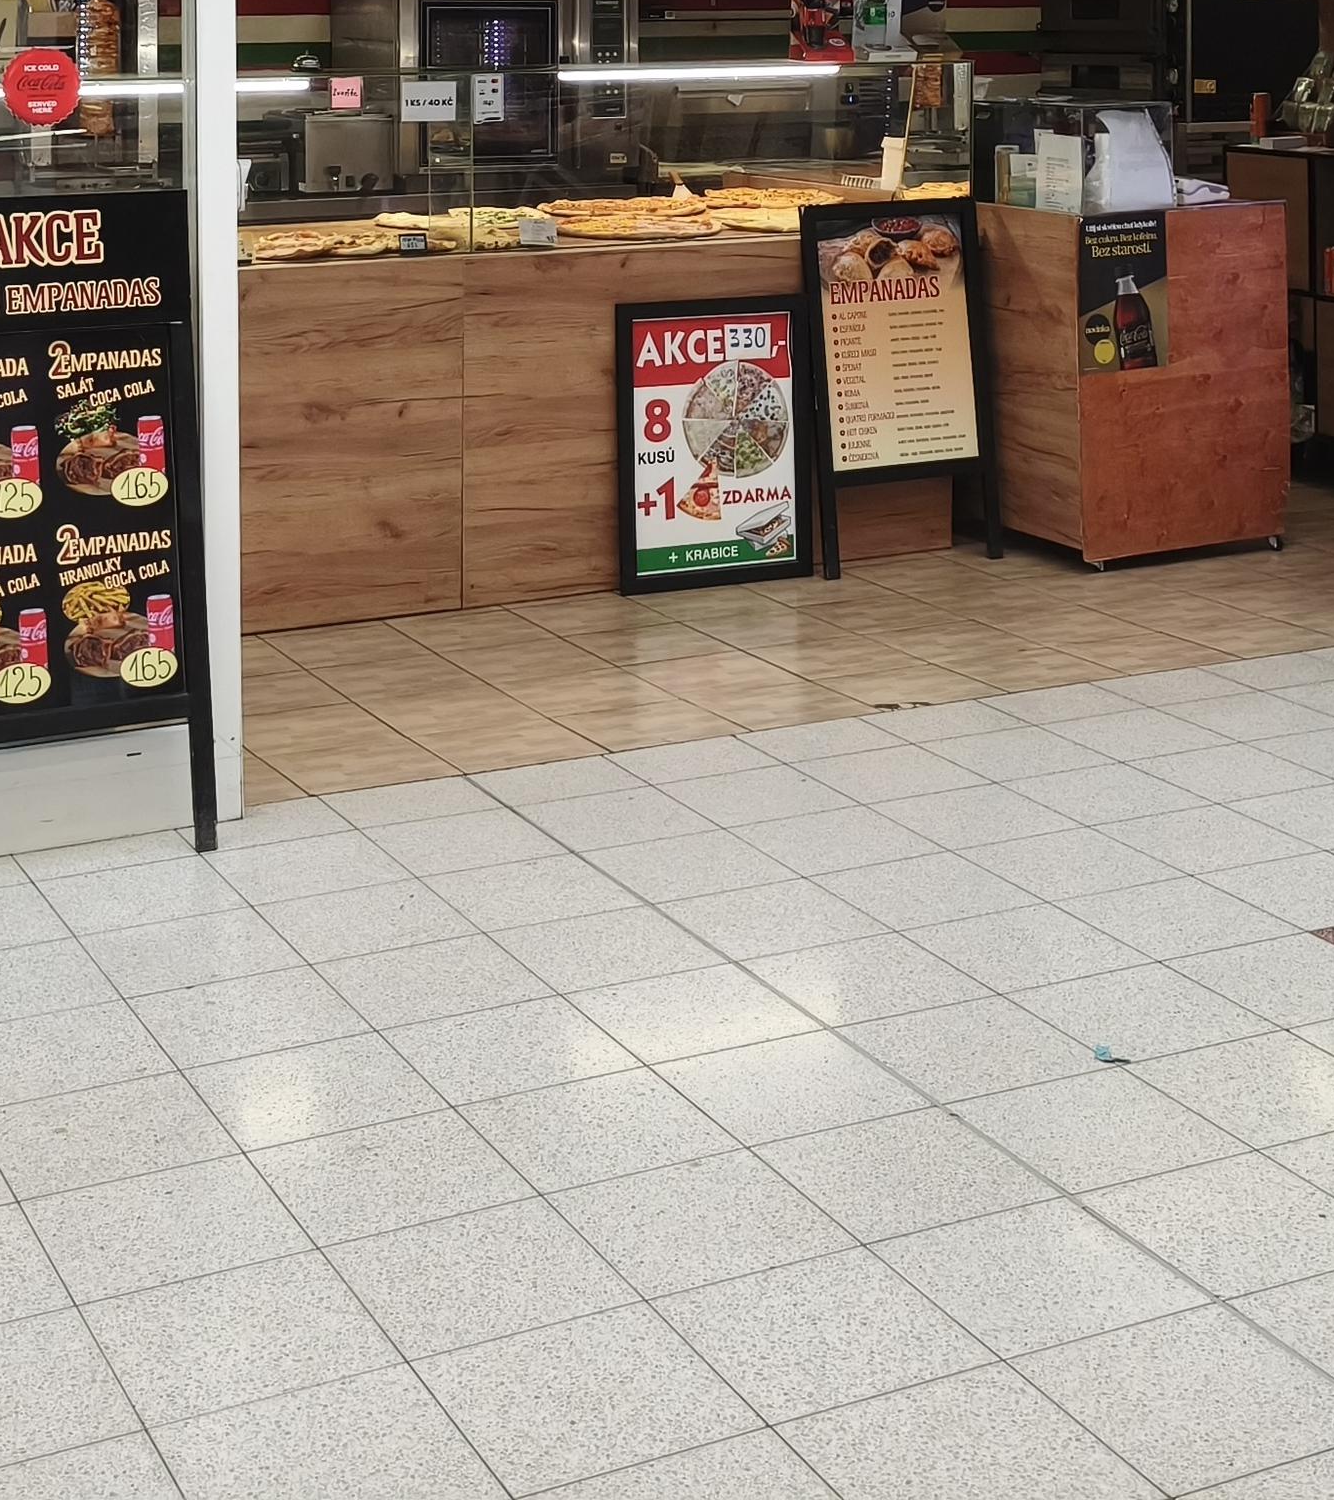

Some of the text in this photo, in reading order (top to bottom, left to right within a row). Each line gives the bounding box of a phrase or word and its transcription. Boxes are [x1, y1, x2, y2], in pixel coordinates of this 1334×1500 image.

[23, 63, 59, 72] ICE COLD
[410, 99, 421, 107] KS
[442, 97, 453, 106] KČ
[1092, 246, 1111, 258] Bez
[6, 277, 161, 314] EMPANADAS
[830, 276, 941, 305] EMPANADAS
[636, 329, 725, 367] AKCE
[56, 378, 94, 399] SALÁT
[90, 380, 155, 407] COCA COLA
[644, 399, 671, 442] 8
[638, 450, 675, 465] KUSŮ
[121, 473, 161, 500] 165
[723, 486, 792, 505] ZDARMA
[686, 546, 738, 562] KRABICE
[8, 574, 40, 594] COLA
[59, 558, 121, 586] HRANOLKY
[105, 560, 169, 590] COCA COLA
[129, 652, 171, 682] 165
